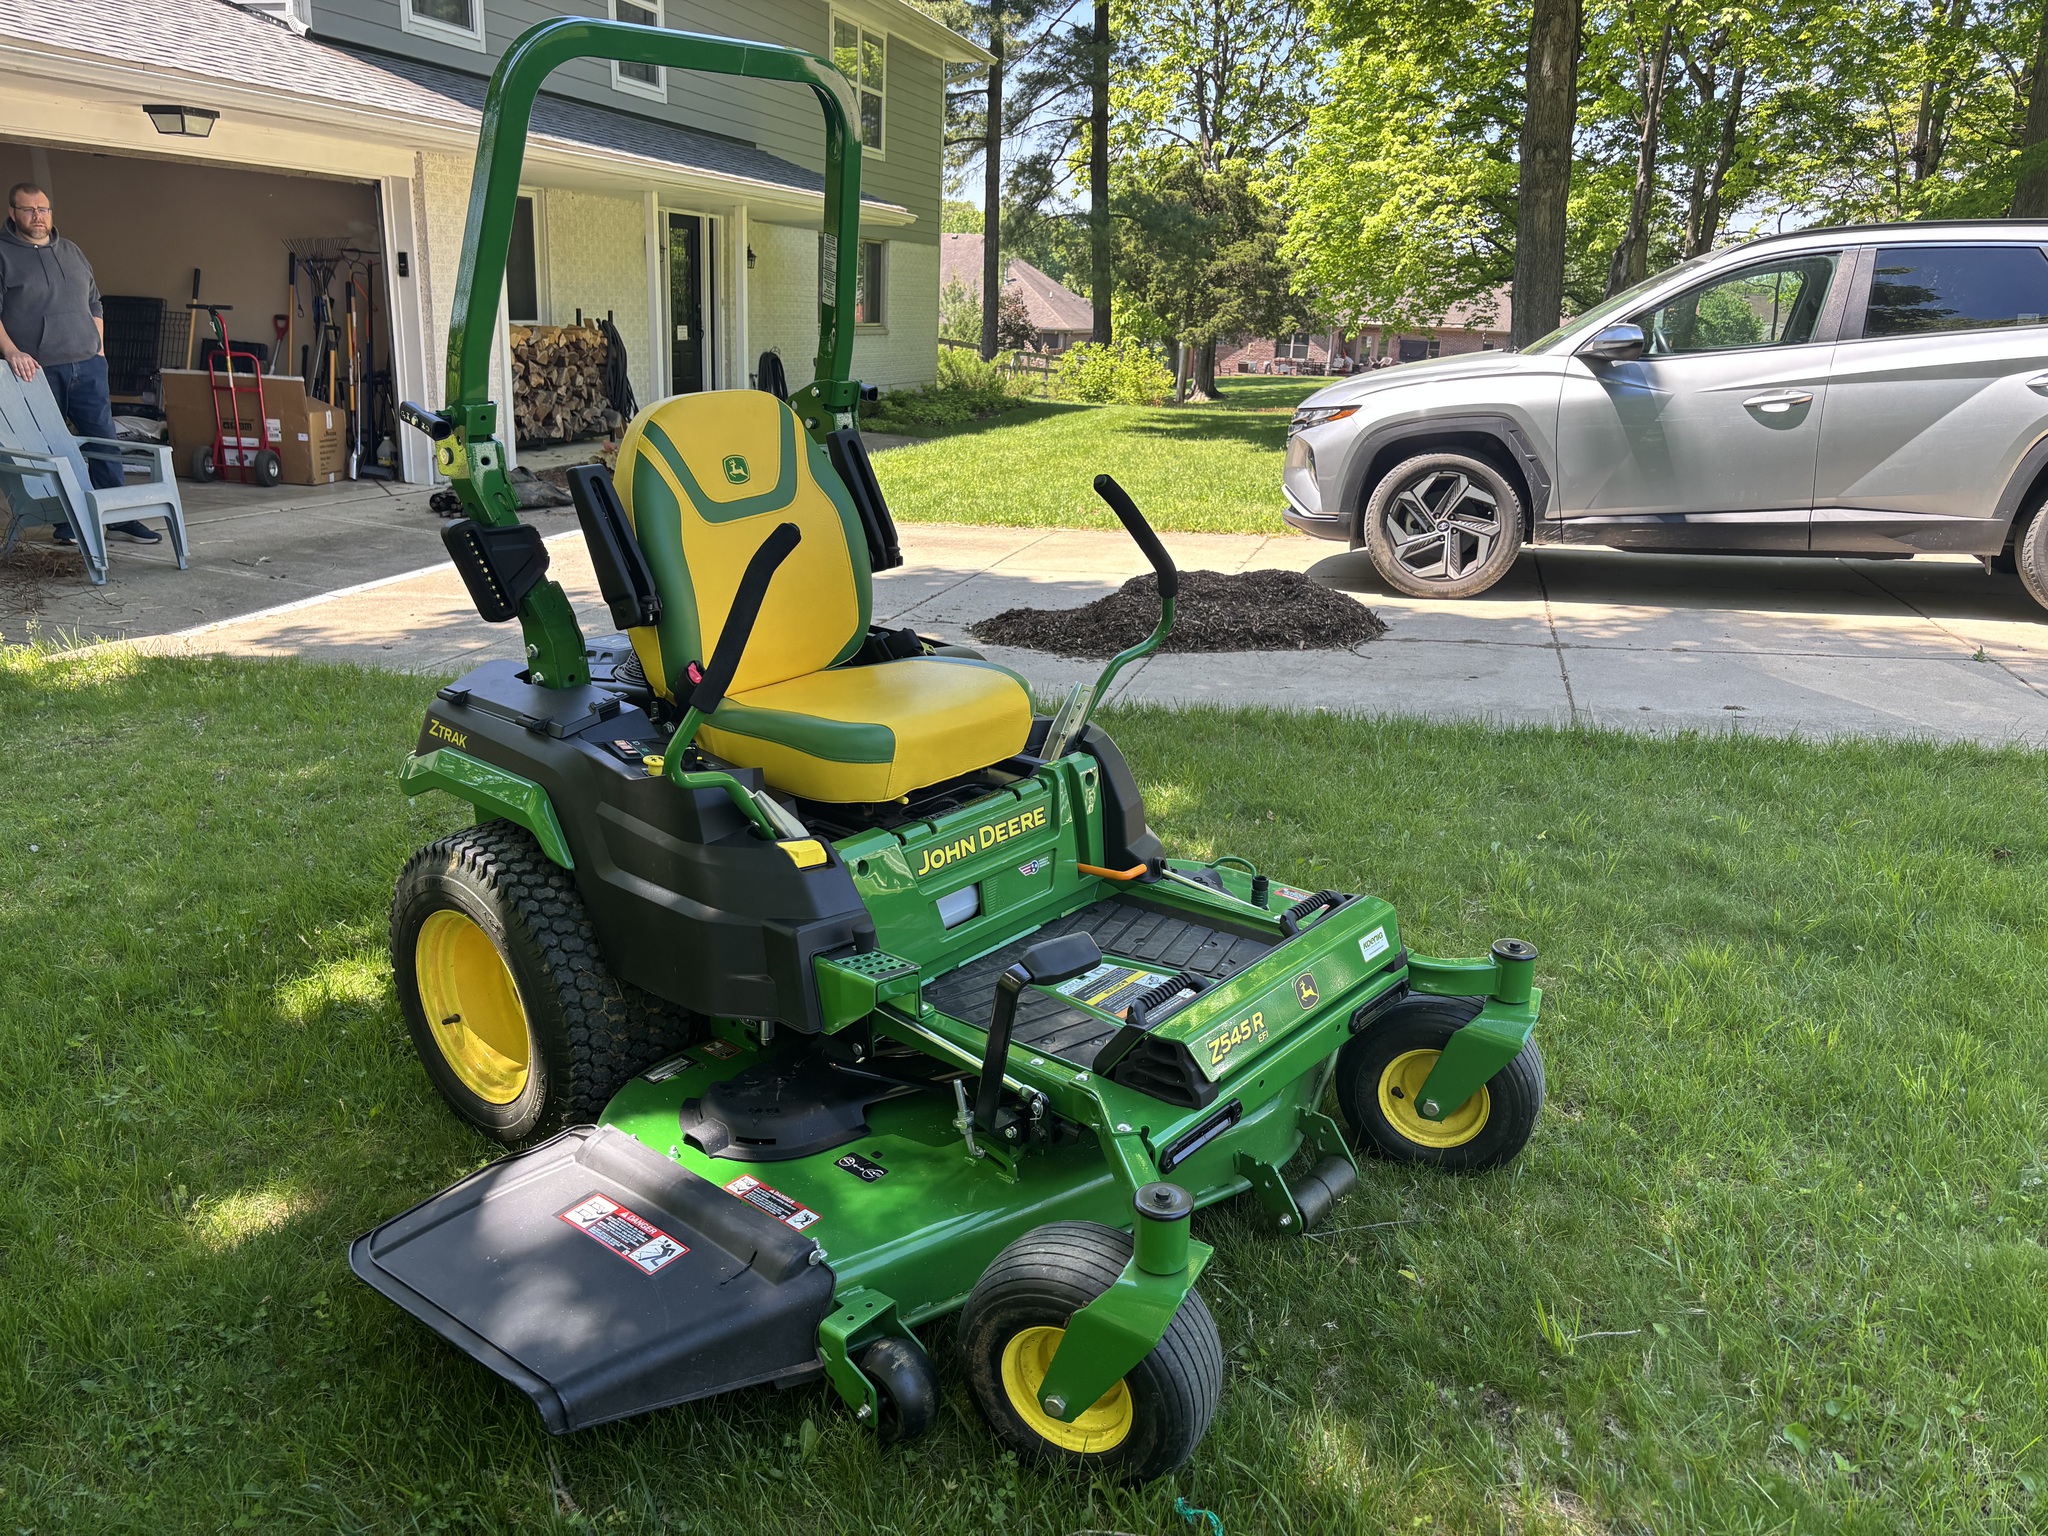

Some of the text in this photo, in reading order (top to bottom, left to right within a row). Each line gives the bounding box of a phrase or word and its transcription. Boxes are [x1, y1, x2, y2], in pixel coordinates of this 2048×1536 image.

[918, 806, 1047, 876] JOHN DEERE
[1207, 1011, 1265, 1066] Z545 R
[1258, 1030, 1269, 1043] EFI
[627, 1215, 658, 1234] DANGER
